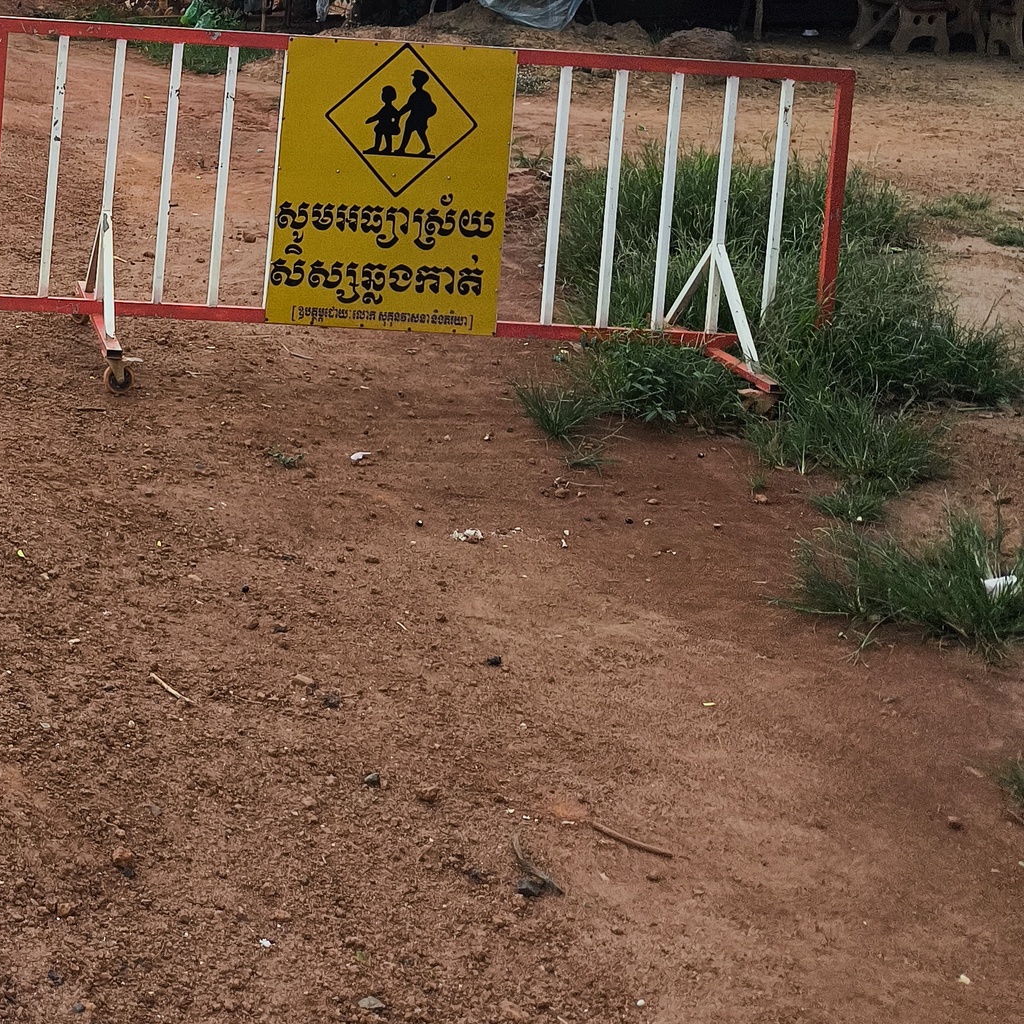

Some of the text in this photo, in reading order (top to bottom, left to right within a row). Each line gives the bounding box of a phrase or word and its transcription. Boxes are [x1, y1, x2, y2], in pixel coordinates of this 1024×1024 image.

[276, 193, 495, 251] សូមអធ្យាស្រ័យ
[269, 243, 485, 305] សិស្សឆ្លងកាត់
